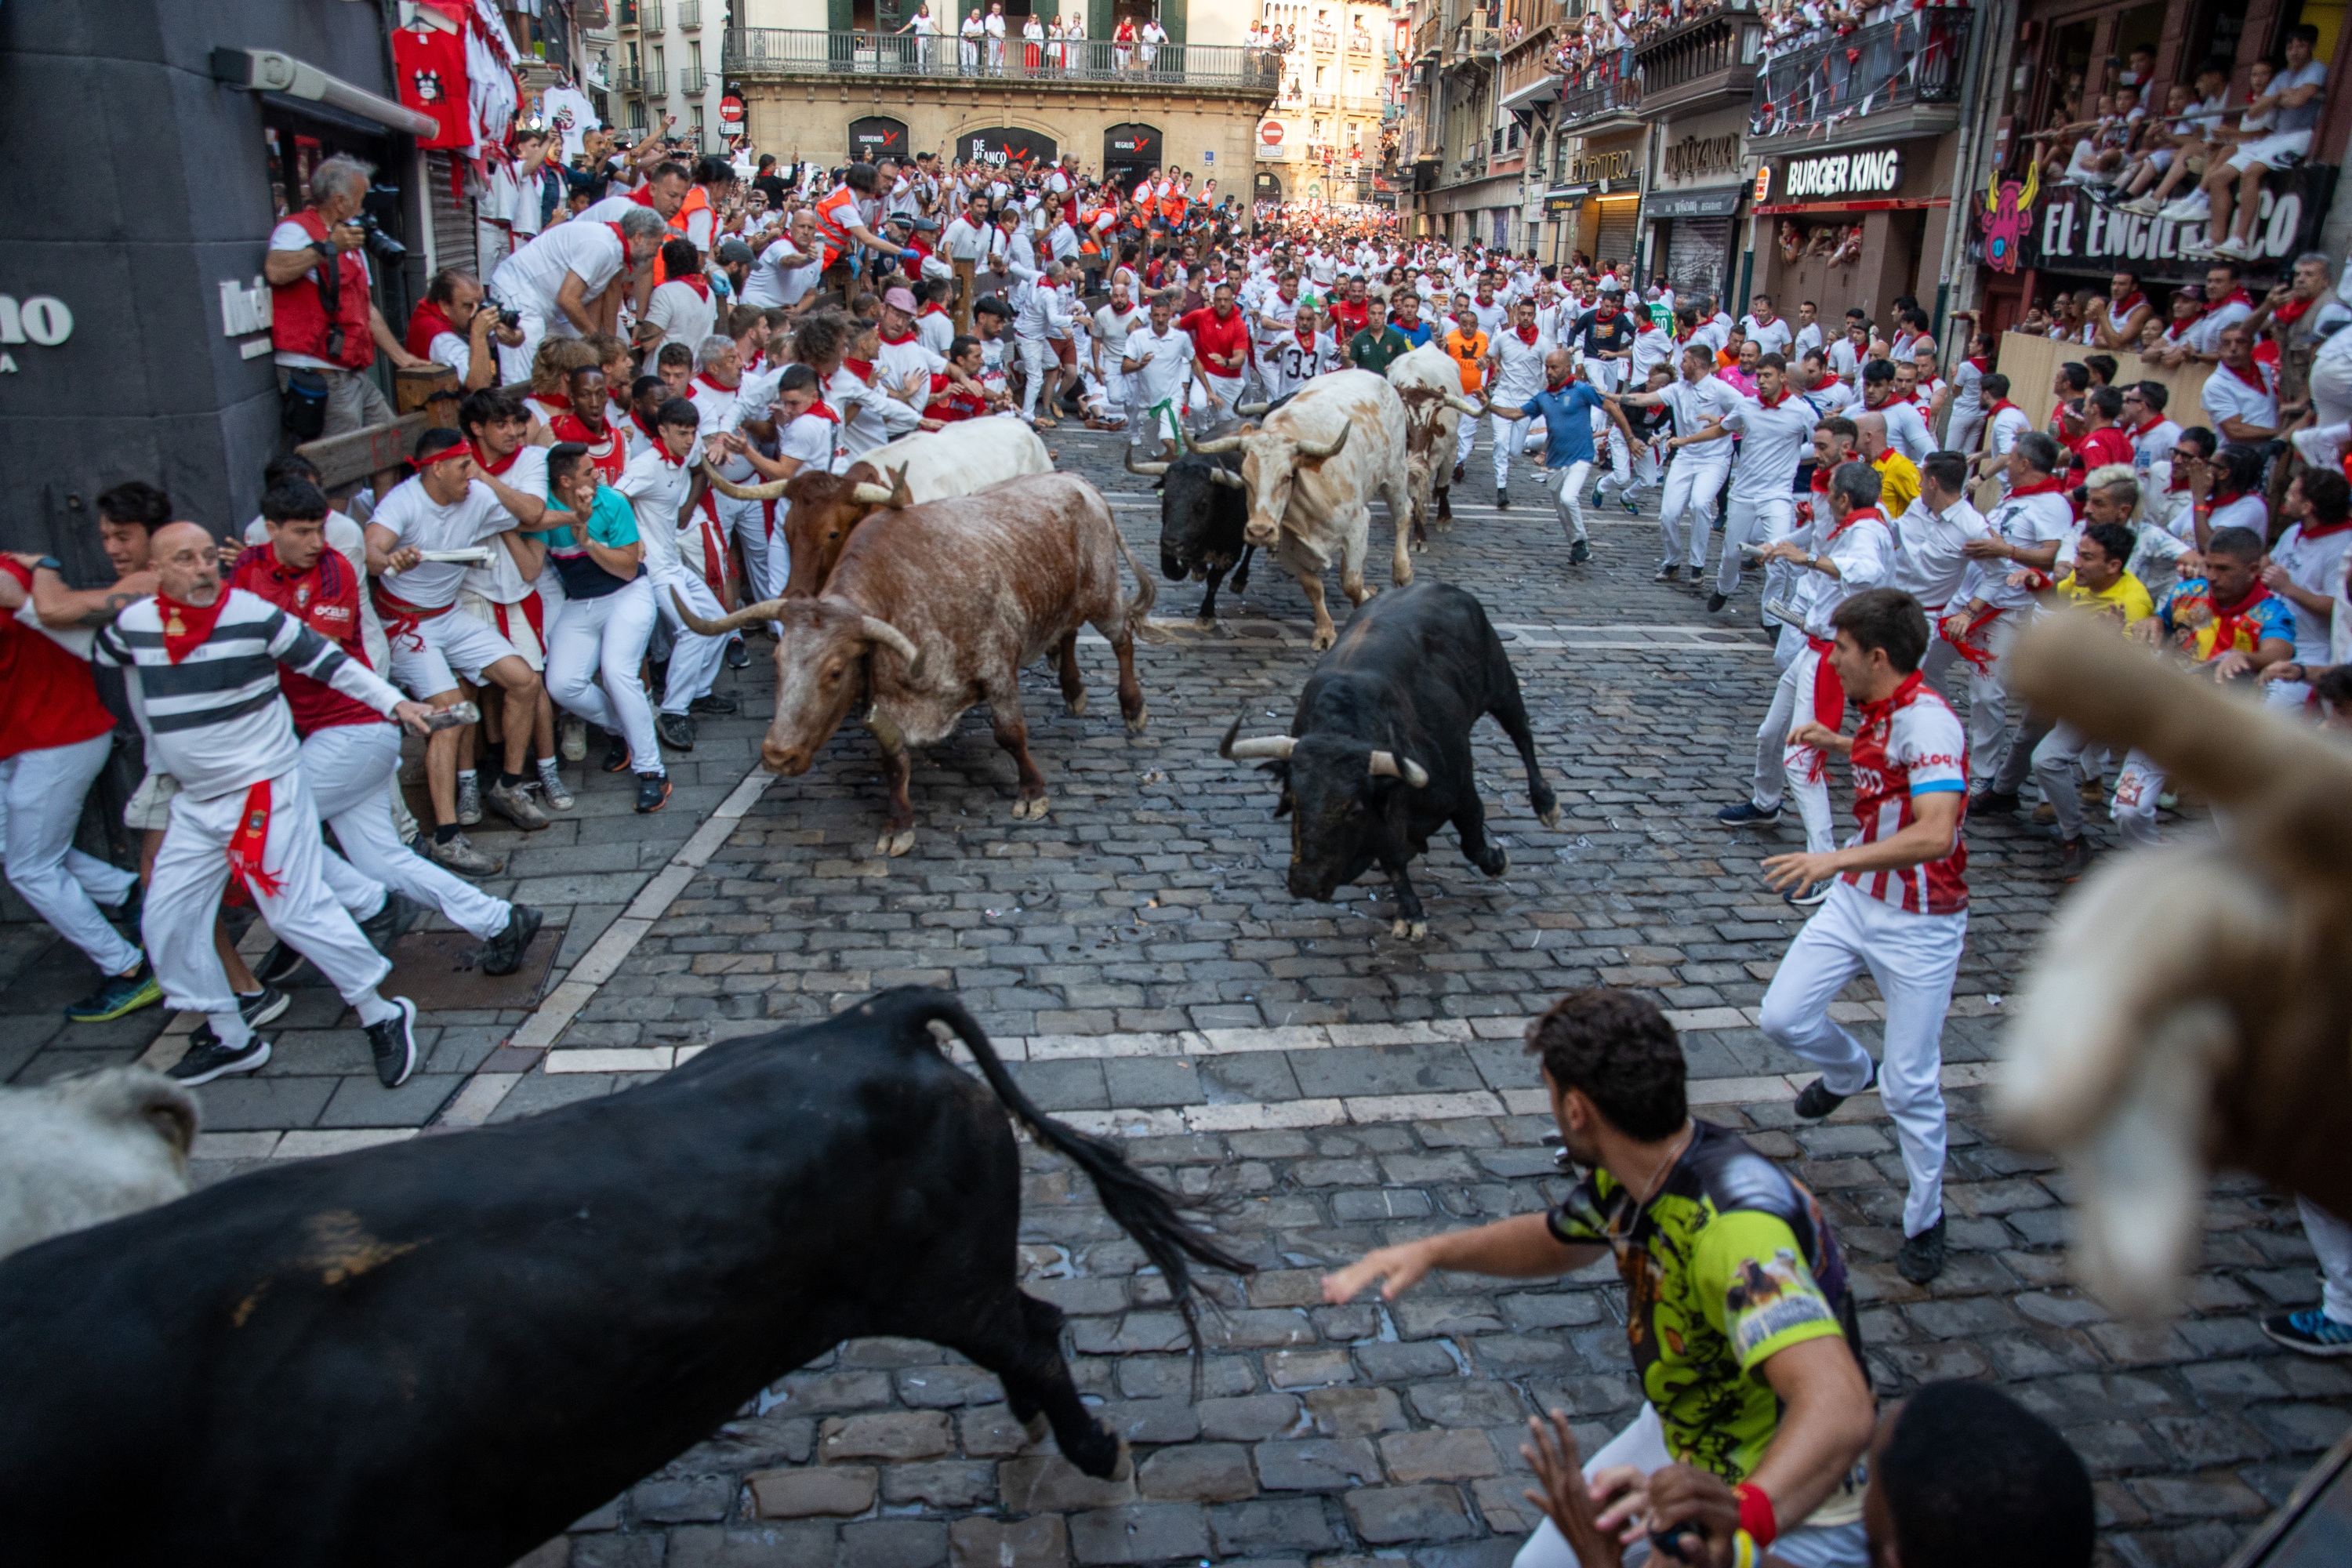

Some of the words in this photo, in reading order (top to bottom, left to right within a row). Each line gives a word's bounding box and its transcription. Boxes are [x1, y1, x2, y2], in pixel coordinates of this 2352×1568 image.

[973, 139, 985, 151] DE
[1786, 154, 1849, 197] BURGER
[1849, 149, 1898, 191] KING
[2042, 202, 2075, 257] EL
[1655, 318, 1668, 332] 20
[1287, 350, 1317, 380] 33
